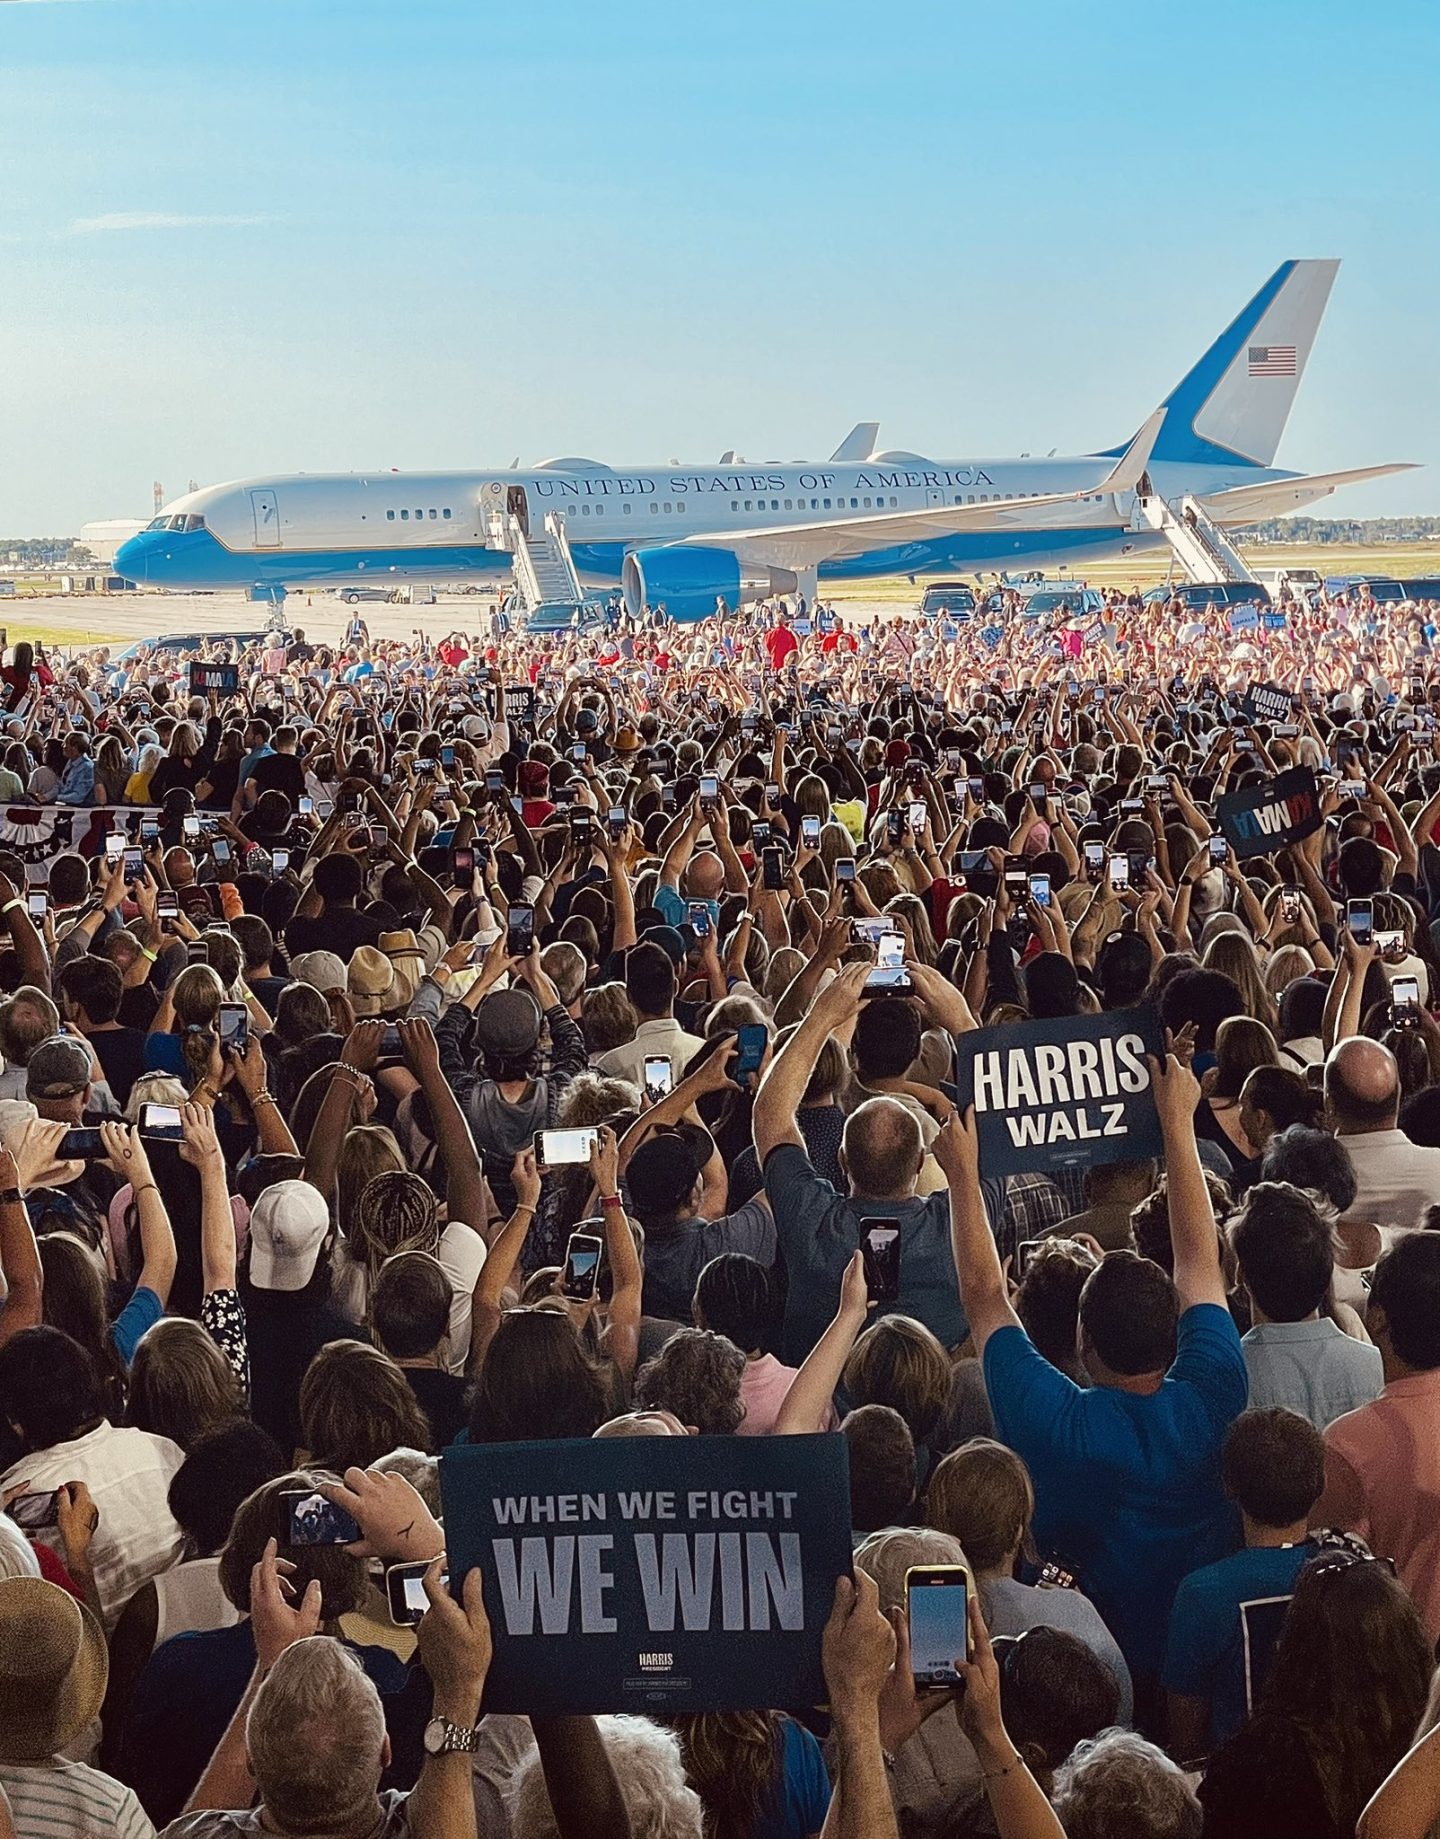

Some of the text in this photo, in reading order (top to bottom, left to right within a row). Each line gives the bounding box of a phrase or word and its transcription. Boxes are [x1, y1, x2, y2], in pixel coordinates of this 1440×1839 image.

[532, 469, 996, 497] UNITED STATES OF AMERICA
[193, 671, 235, 687] KAMALA
[1255, 702, 1285, 718] WALZ
[1231, 791, 1313, 838] KAMALA
[974, 1034, 1150, 1112] HARRIS
[1006, 1103, 1128, 1148] WALZ
[492, 1490, 798, 1524] WHEN WE FIGHT
[491, 1532, 804, 1635] WE WIN
[639, 1653, 674, 1666] HARRIS
